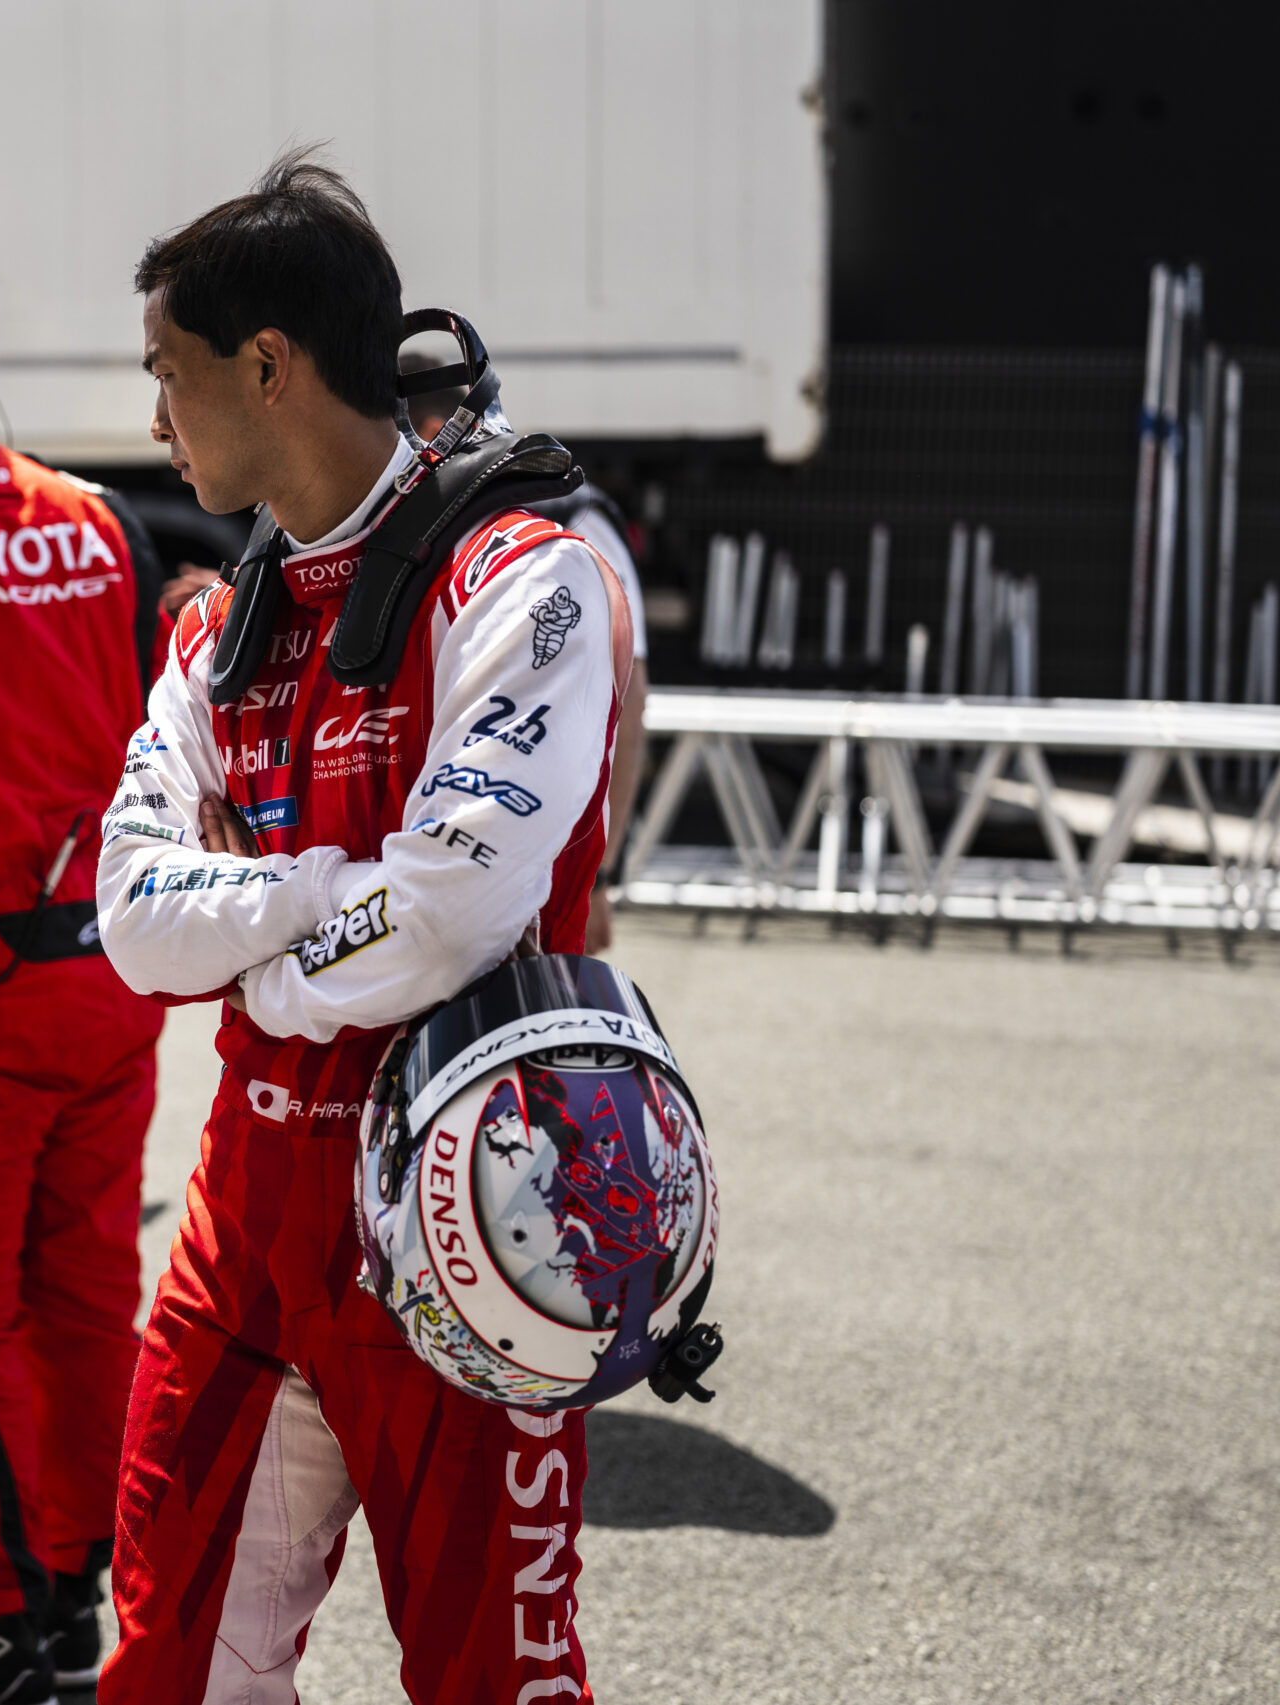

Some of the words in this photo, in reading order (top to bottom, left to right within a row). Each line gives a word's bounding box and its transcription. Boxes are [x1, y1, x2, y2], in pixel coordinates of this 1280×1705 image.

[294, 556, 363, 584] TOYOT
[304, 577, 356, 592] RACI
[270, 629, 312, 664] TSU
[312, 759, 326, 769] FIA
[421, 763, 542, 817] RAYS
[422, 822, 498, 869] JFE
[288, 892, 386, 972] eePer
[436, 1019, 601, 1097] RACING
[286, 1100, 305, 1116] R.
[309, 1102, 362, 1118] HIRA
[430, 1129, 478, 1287] DENSO
